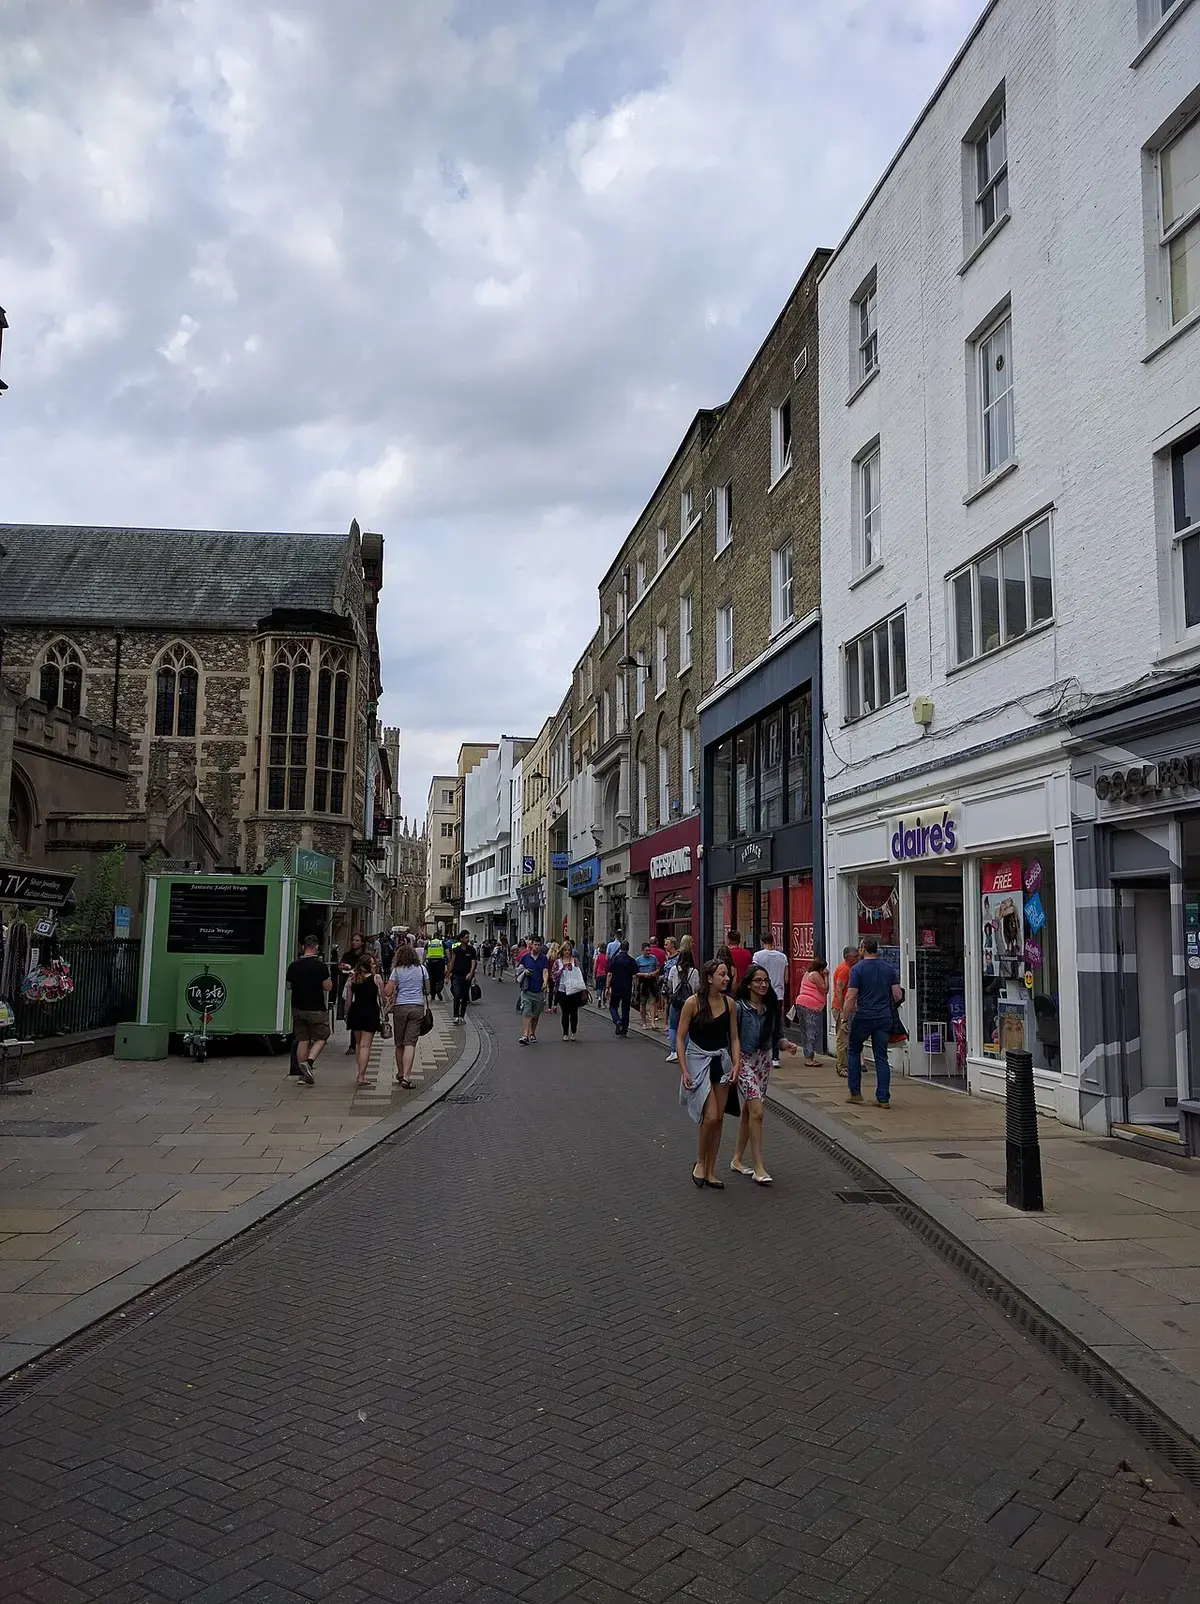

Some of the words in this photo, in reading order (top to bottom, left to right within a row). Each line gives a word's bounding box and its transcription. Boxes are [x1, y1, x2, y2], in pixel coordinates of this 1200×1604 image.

[892, 811, 955, 859] claire's
[650, 845, 692, 880] OFFSPRING
[4, 874, 28, 894] TV
[992, 873, 1013, 890] FREE
[216, 928, 235, 936] Wraps
[792, 926, 815, 958] SALE
[188, 984, 224, 999] Taste
